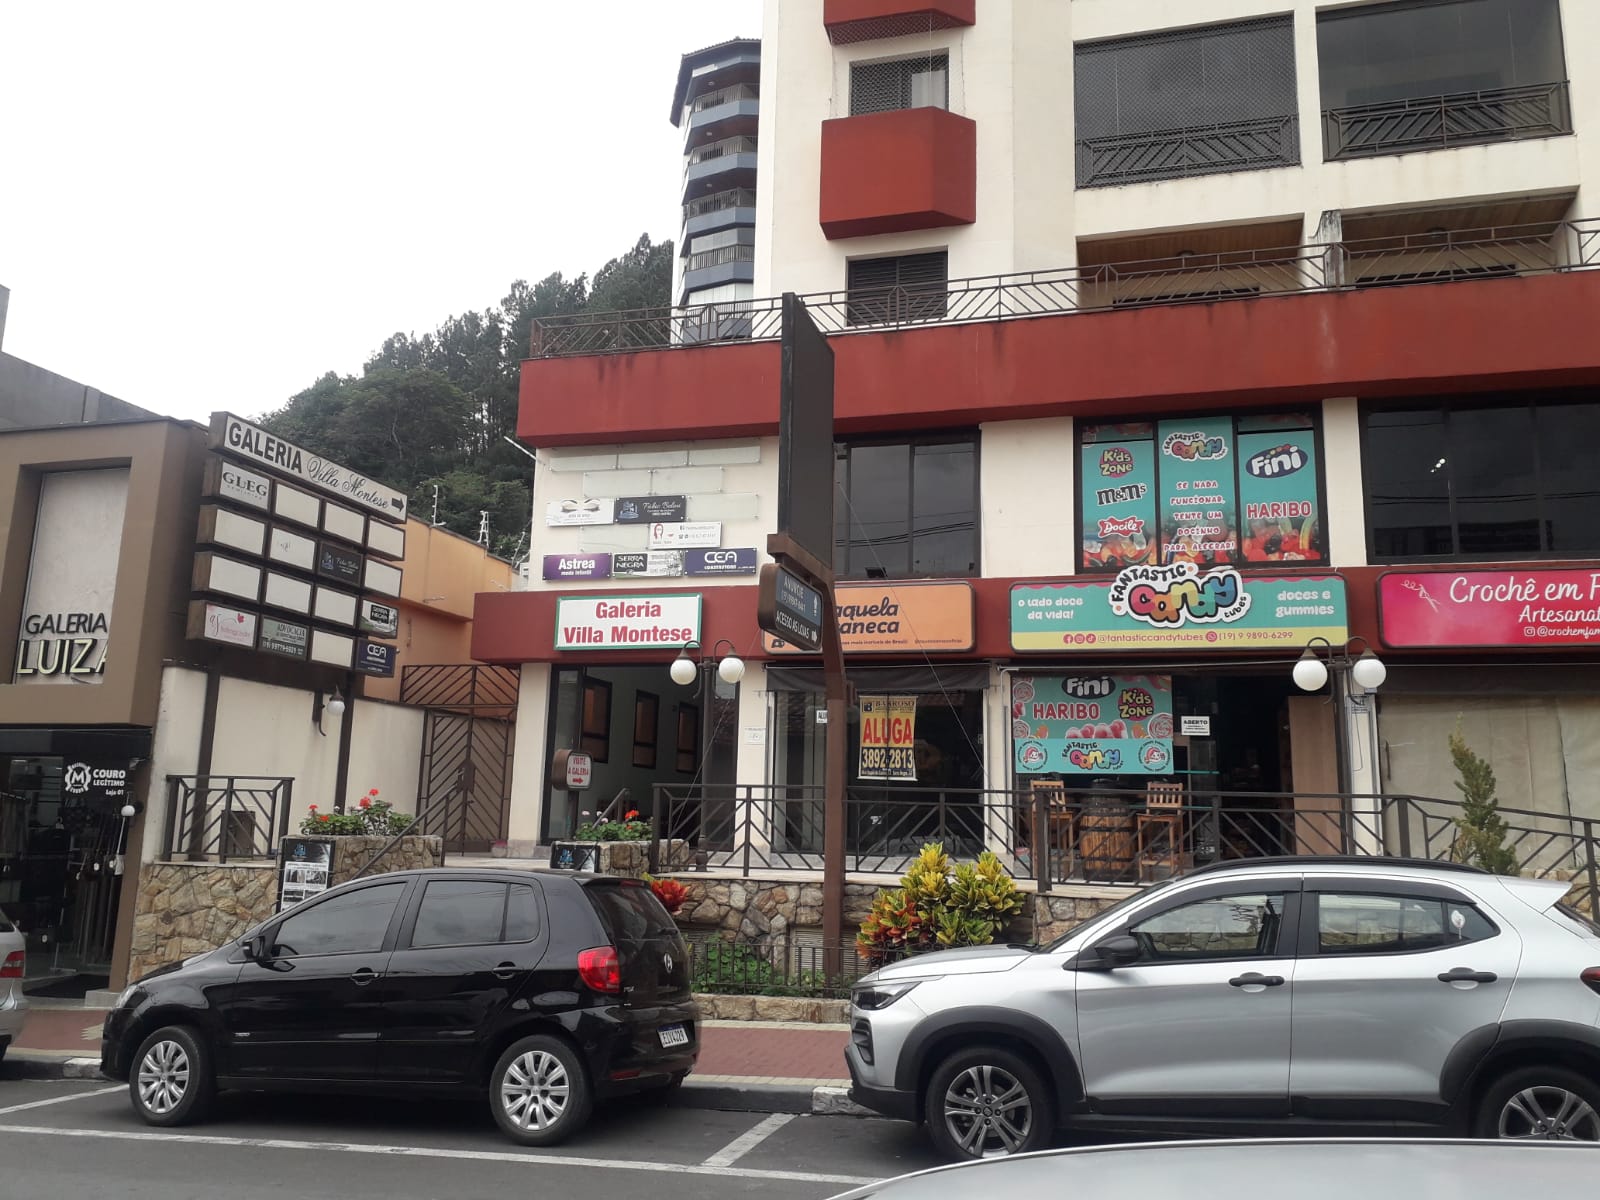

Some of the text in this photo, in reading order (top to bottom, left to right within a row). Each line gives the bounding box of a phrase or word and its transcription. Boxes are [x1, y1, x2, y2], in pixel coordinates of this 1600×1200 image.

[1164, 432, 1201, 450] FANTASTIC
[1103, 449, 1131, 463] Kids
[1251, 446, 1301, 475] Fini
[229, 422, 389, 509] GALERIA Villa Montese
[222, 471, 268, 497] GLEG
[1177, 481, 1218, 490] SE NADA
[1174, 511, 1222, 520] TENTE UM
[1247, 501, 1311, 519] HARIBO
[1104, 520, 1138, 533] Docile
[1177, 527, 1220, 536] DOCINHO
[1164, 544, 1186, 552] PARA
[558, 558, 596, 570] Astrea
[704, 551, 737, 564] CEA
[1112, 564, 1187, 602] FANTASTIC
[1450, 576, 1539, 602] Crochê
[1545, 583, 1584, 601] em
[1027, 597, 1052, 606] lado
[1055, 597, 1083, 606] doce
[1277, 591, 1331, 601] doces e
[595, 601, 661, 619] Galeria
[1224, 596, 1247, 618] tubes
[1275, 604, 1335, 618] gummies
[1027, 610, 1074, 620] da vida!
[25, 612, 107, 634] GALERIA
[838, 621, 900, 635] aneca
[564, 625, 692, 643] Villa Montese
[1098, 633, 1203, 643] @fantasticcandytubes
[1219, 632, 1236, 641] (19)
[1247, 631, 1294, 639] 9890-6299
[1067, 676, 1110, 697] Fini
[1122, 689, 1152, 704] Kids
[1033, 703, 1100, 720] HARIBO
[863, 717, 913, 745] ALUGA
[1061, 741, 1098, 757] FANTASTIC
[93, 769, 126, 779] COURO
[93, 778, 125, 787] LEGÍTIMO
